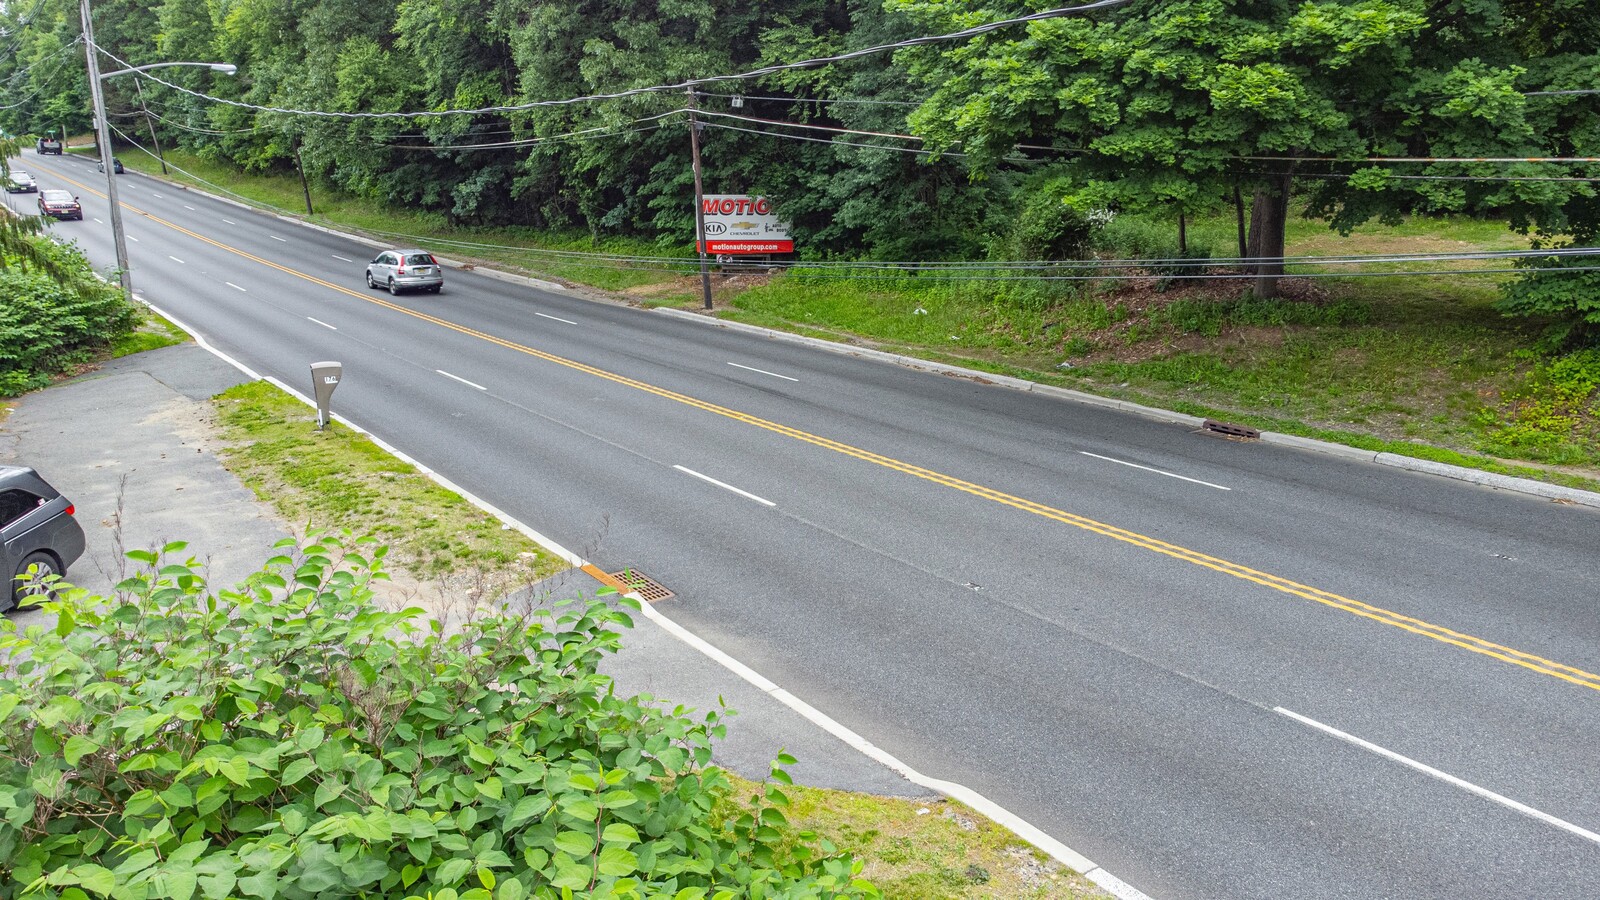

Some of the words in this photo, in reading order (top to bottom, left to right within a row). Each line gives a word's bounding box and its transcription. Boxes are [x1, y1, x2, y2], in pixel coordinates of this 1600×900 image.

[702, 198, 772, 215] MOTIO
[705, 224, 723, 233] KIA
[712, 243, 778, 251] motionautogroup.com
